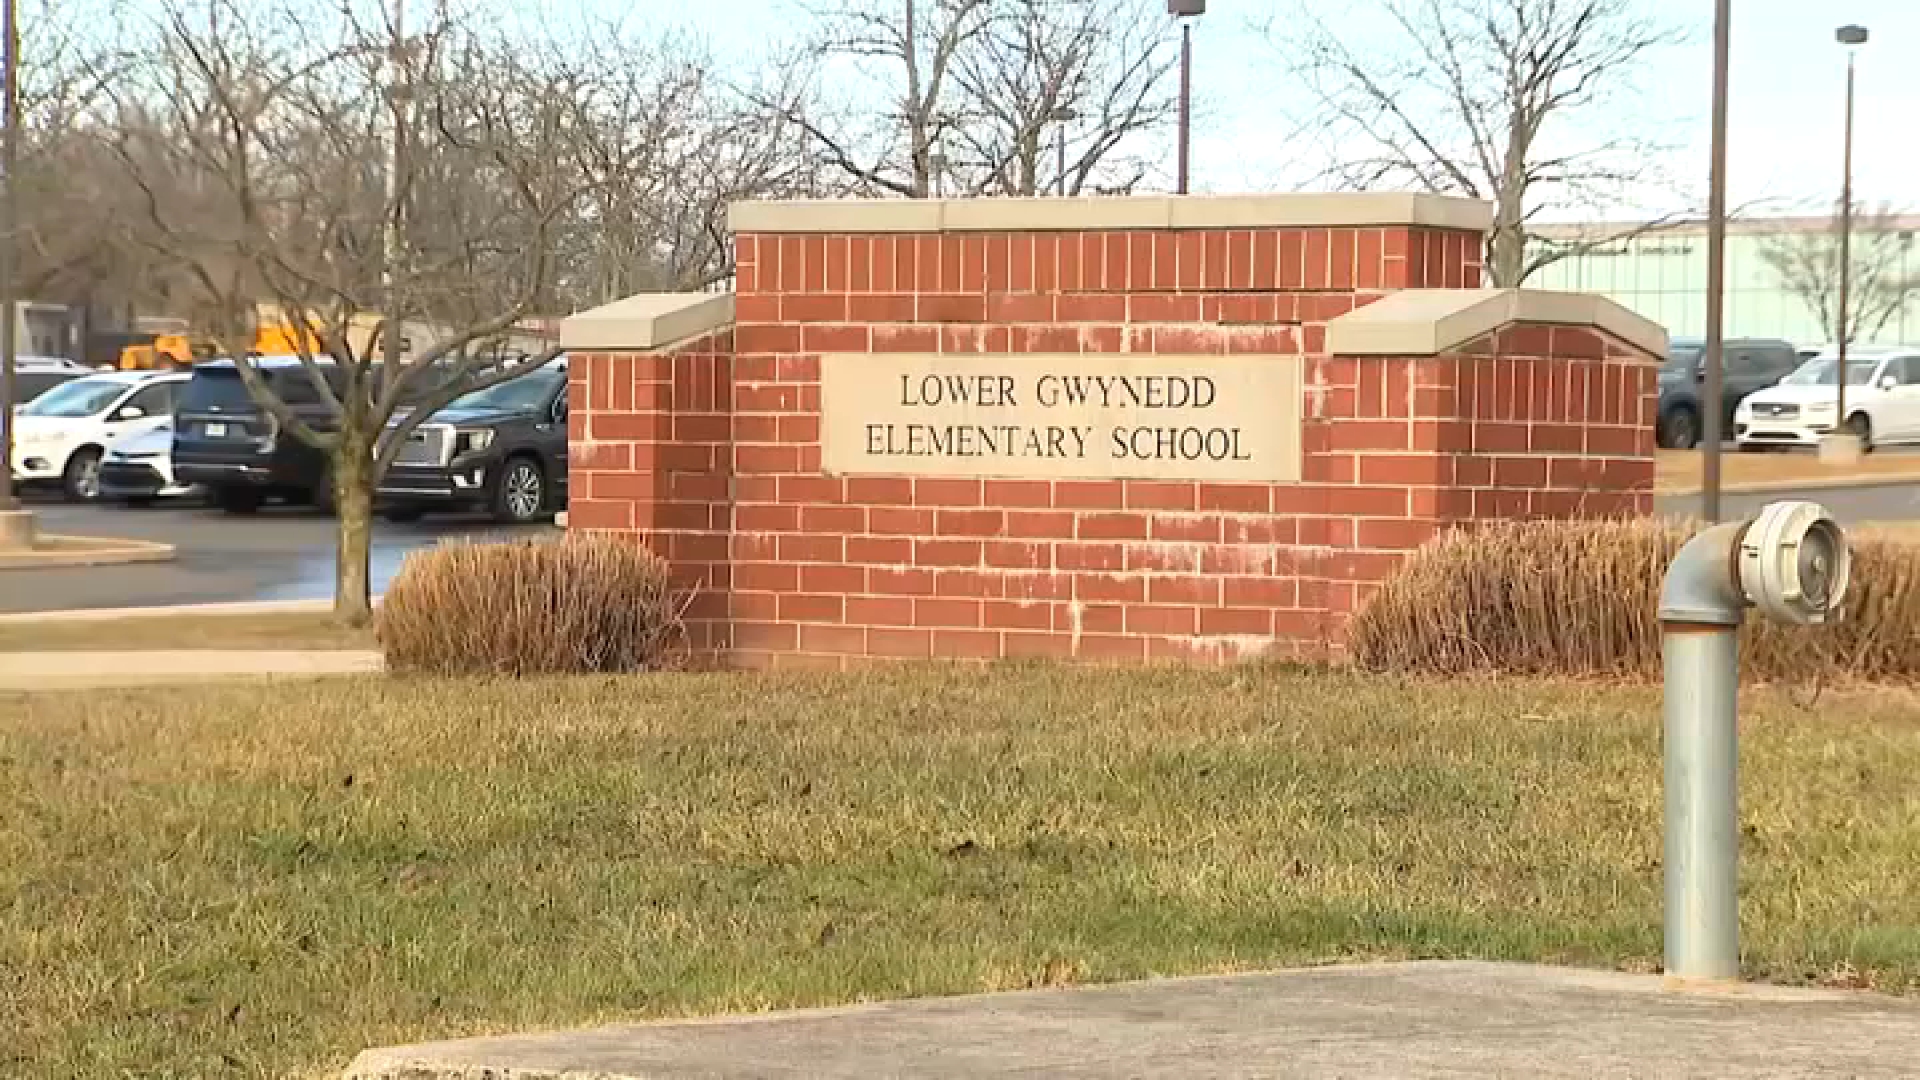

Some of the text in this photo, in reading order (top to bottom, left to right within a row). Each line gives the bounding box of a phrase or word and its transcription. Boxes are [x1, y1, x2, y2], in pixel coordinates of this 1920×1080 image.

[900, 374, 1216, 409] LOWER GWYNEDD
[865, 424, 1252, 461] ELEMENTARY SCHOOL
